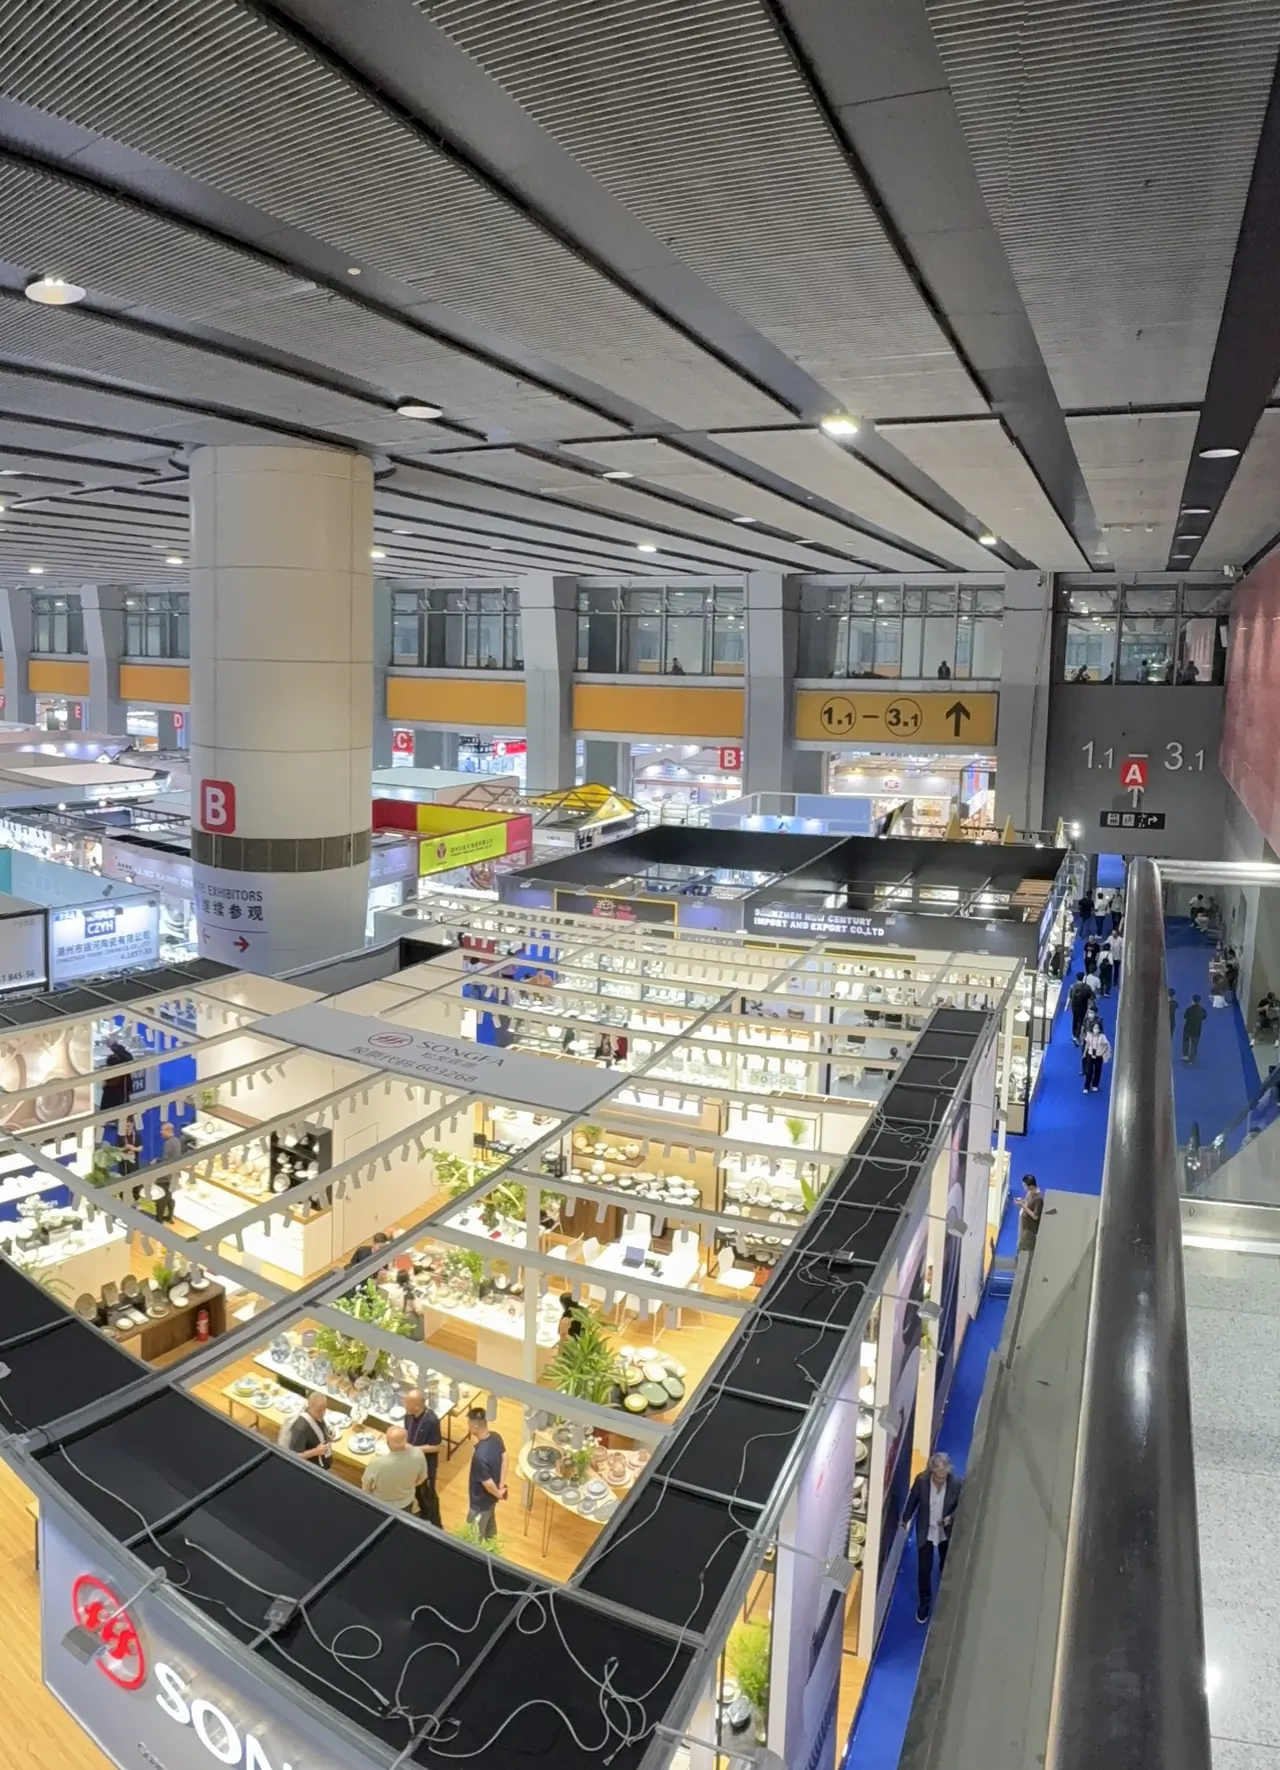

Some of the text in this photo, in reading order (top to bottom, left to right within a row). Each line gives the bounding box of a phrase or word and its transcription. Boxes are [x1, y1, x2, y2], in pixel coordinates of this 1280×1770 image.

[75, 707, 81, 718] E
[823, 707, 852, 725] 1.1
[888, 708, 918, 727] 3.1
[174, 714, 183, 727] D
[396, 733, 408, 748] C
[724, 753, 736, 766] B
[1082, 741, 1115, 769] 1.1
[1164, 742, 1204, 771] 3.1
[1125, 764, 1143, 783] A
[206, 786, 227, 826] B
[208, 885, 264, 902] EXHIBITORS
[87, 920, 114, 935] CZYH
[753, 917, 787, 928] IMPORT
[789, 920, 809, 930] AND
[810, 921, 847, 932] EXPORT
[828, 914, 872, 926] CENTURY
[416, 1040, 504, 1067] SONGFA
